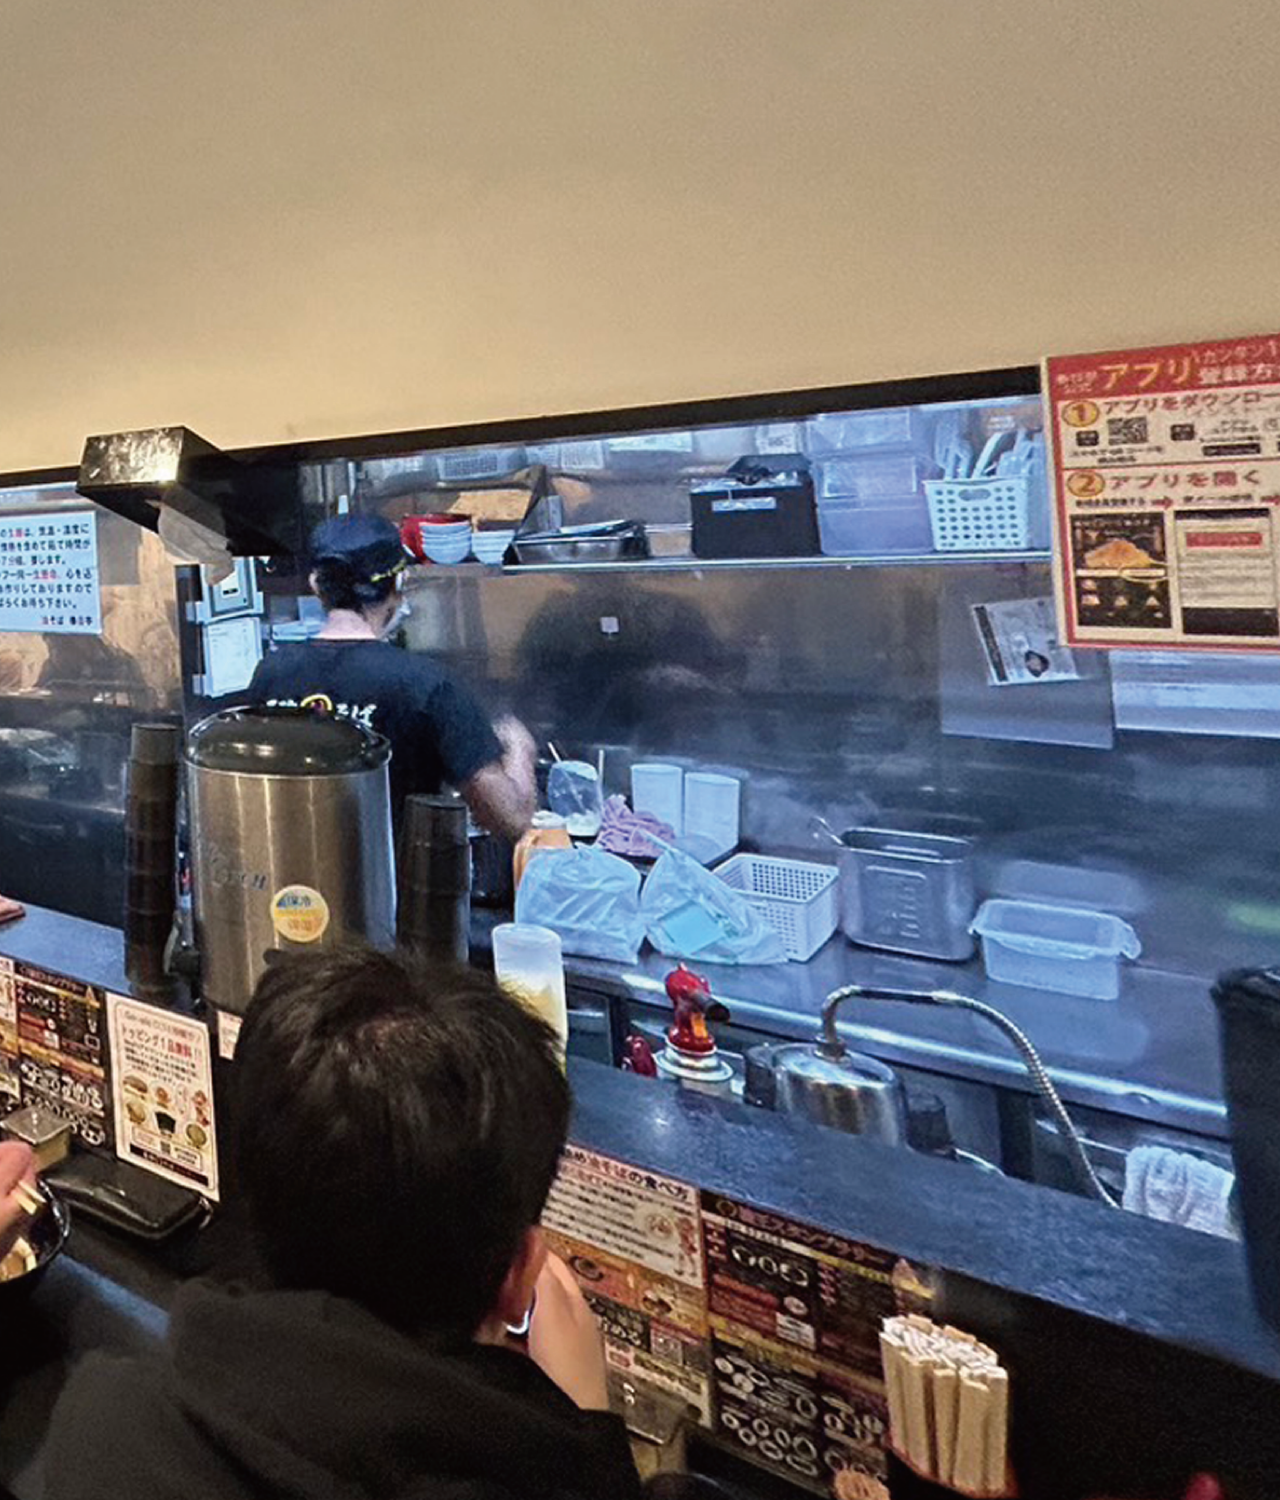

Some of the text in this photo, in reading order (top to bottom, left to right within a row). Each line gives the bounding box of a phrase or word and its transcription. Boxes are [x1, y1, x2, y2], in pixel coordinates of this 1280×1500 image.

[1097, 356, 1192, 390] アプリ
[1199, 363, 1280, 385] 登録方
[1108, 470, 1261, 489] アプリを開く
